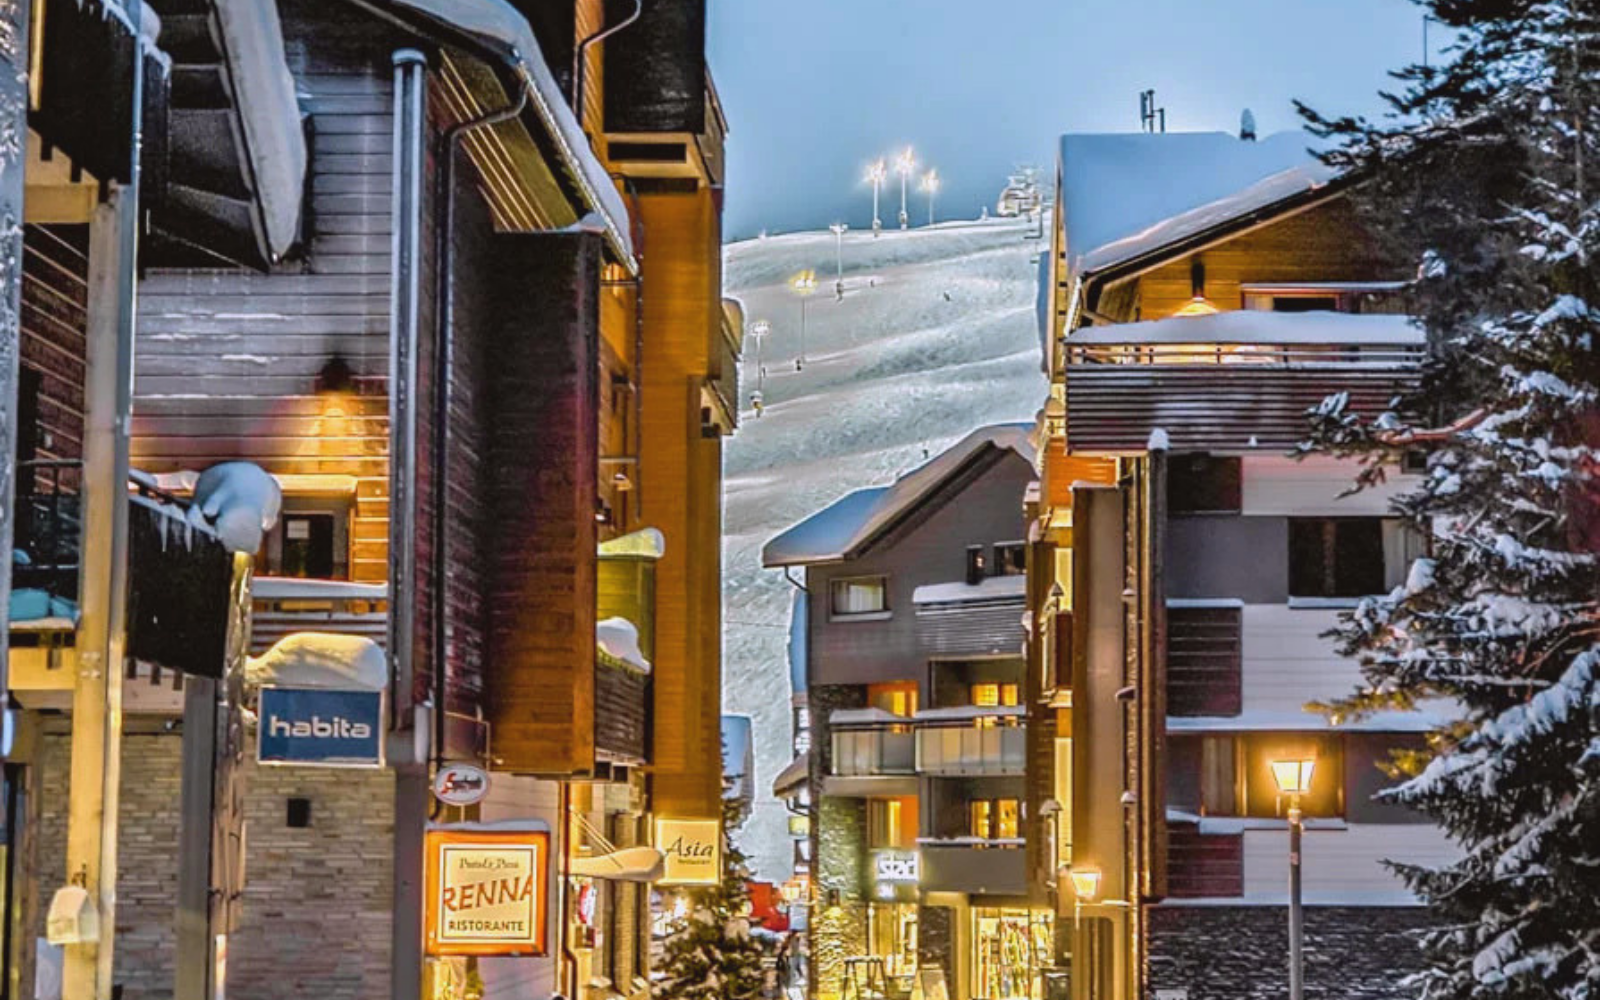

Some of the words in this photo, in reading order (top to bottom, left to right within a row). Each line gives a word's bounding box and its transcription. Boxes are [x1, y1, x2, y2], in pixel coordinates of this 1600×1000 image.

[269, 714, 371, 739] habita
[666, 836, 714, 858] Asia
[448, 920, 524, 932] RISTORANTE
